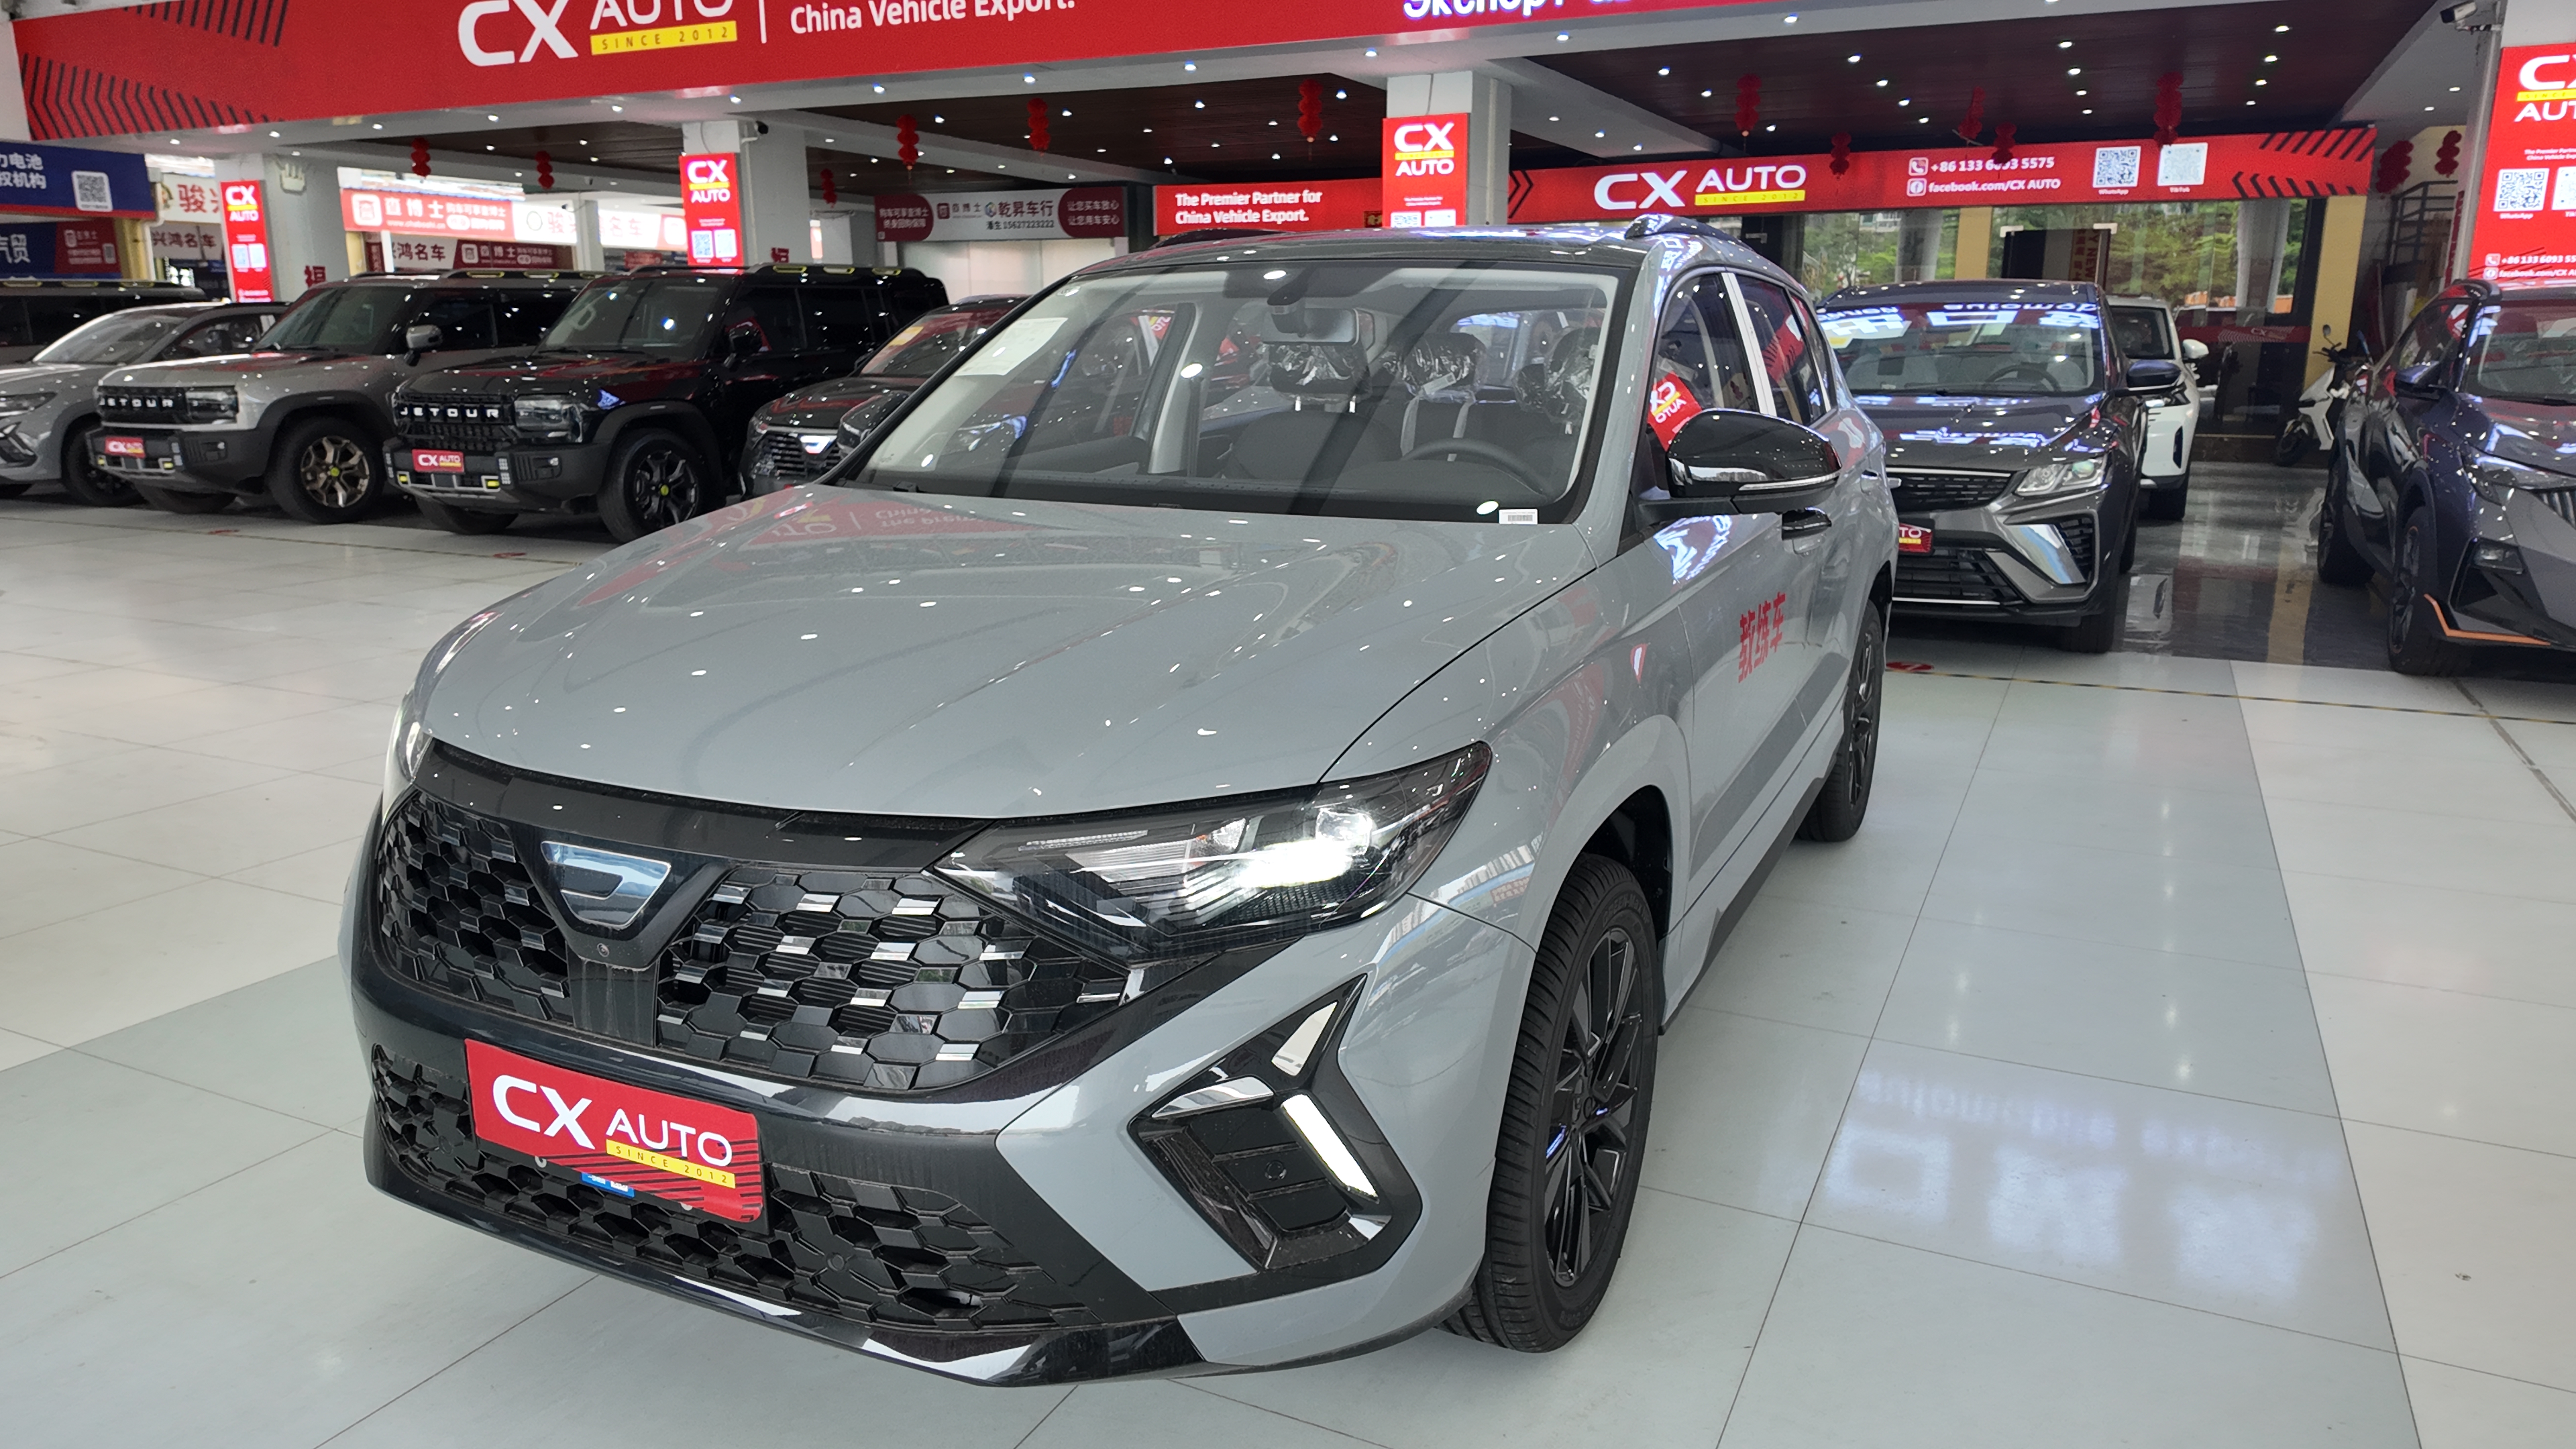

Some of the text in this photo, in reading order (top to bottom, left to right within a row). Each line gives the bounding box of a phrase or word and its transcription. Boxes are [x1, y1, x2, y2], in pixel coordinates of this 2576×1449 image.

[790, 2, 862, 34] China
[869, 0, 966, 26] Vehicle
[458, 0, 578, 66] CX
[602, 26, 729, 50] SINCE 2012
[2519, 54, 2576, 90] C
[1394, 121, 1454, 152] CX
[688, 160, 729, 183] CX
[1395, 159, 1454, 176] AUTO
[1931, 161, 1956, 172] +86
[1959, 160, 1983, 171] 133
[2021, 157, 2055, 169] 5575
[225, 184, 258, 205] CX
[1594, 165, 1806, 210] CX AUTO
[1929, 178, 2061, 192] facebook.com/CX AUTO
[691, 189, 730, 203] AUTO
[1175, 190, 1323, 206] The Premier Partner for
[229, 210, 259, 221] AUTO
[1175, 209, 1309, 224] China Vehicle Export.
[599, 216, 641, 237] 名车
[400, 407, 499, 418] JETOUR
[418, 454, 460, 466] CX AUTO
[1899, 527, 1922, 538] TO
[1738, 592, 1786, 683] 教练车
[492, 1075, 732, 1167] CX AUTO
[616, 1146, 728, 1184] SINCE 2012
